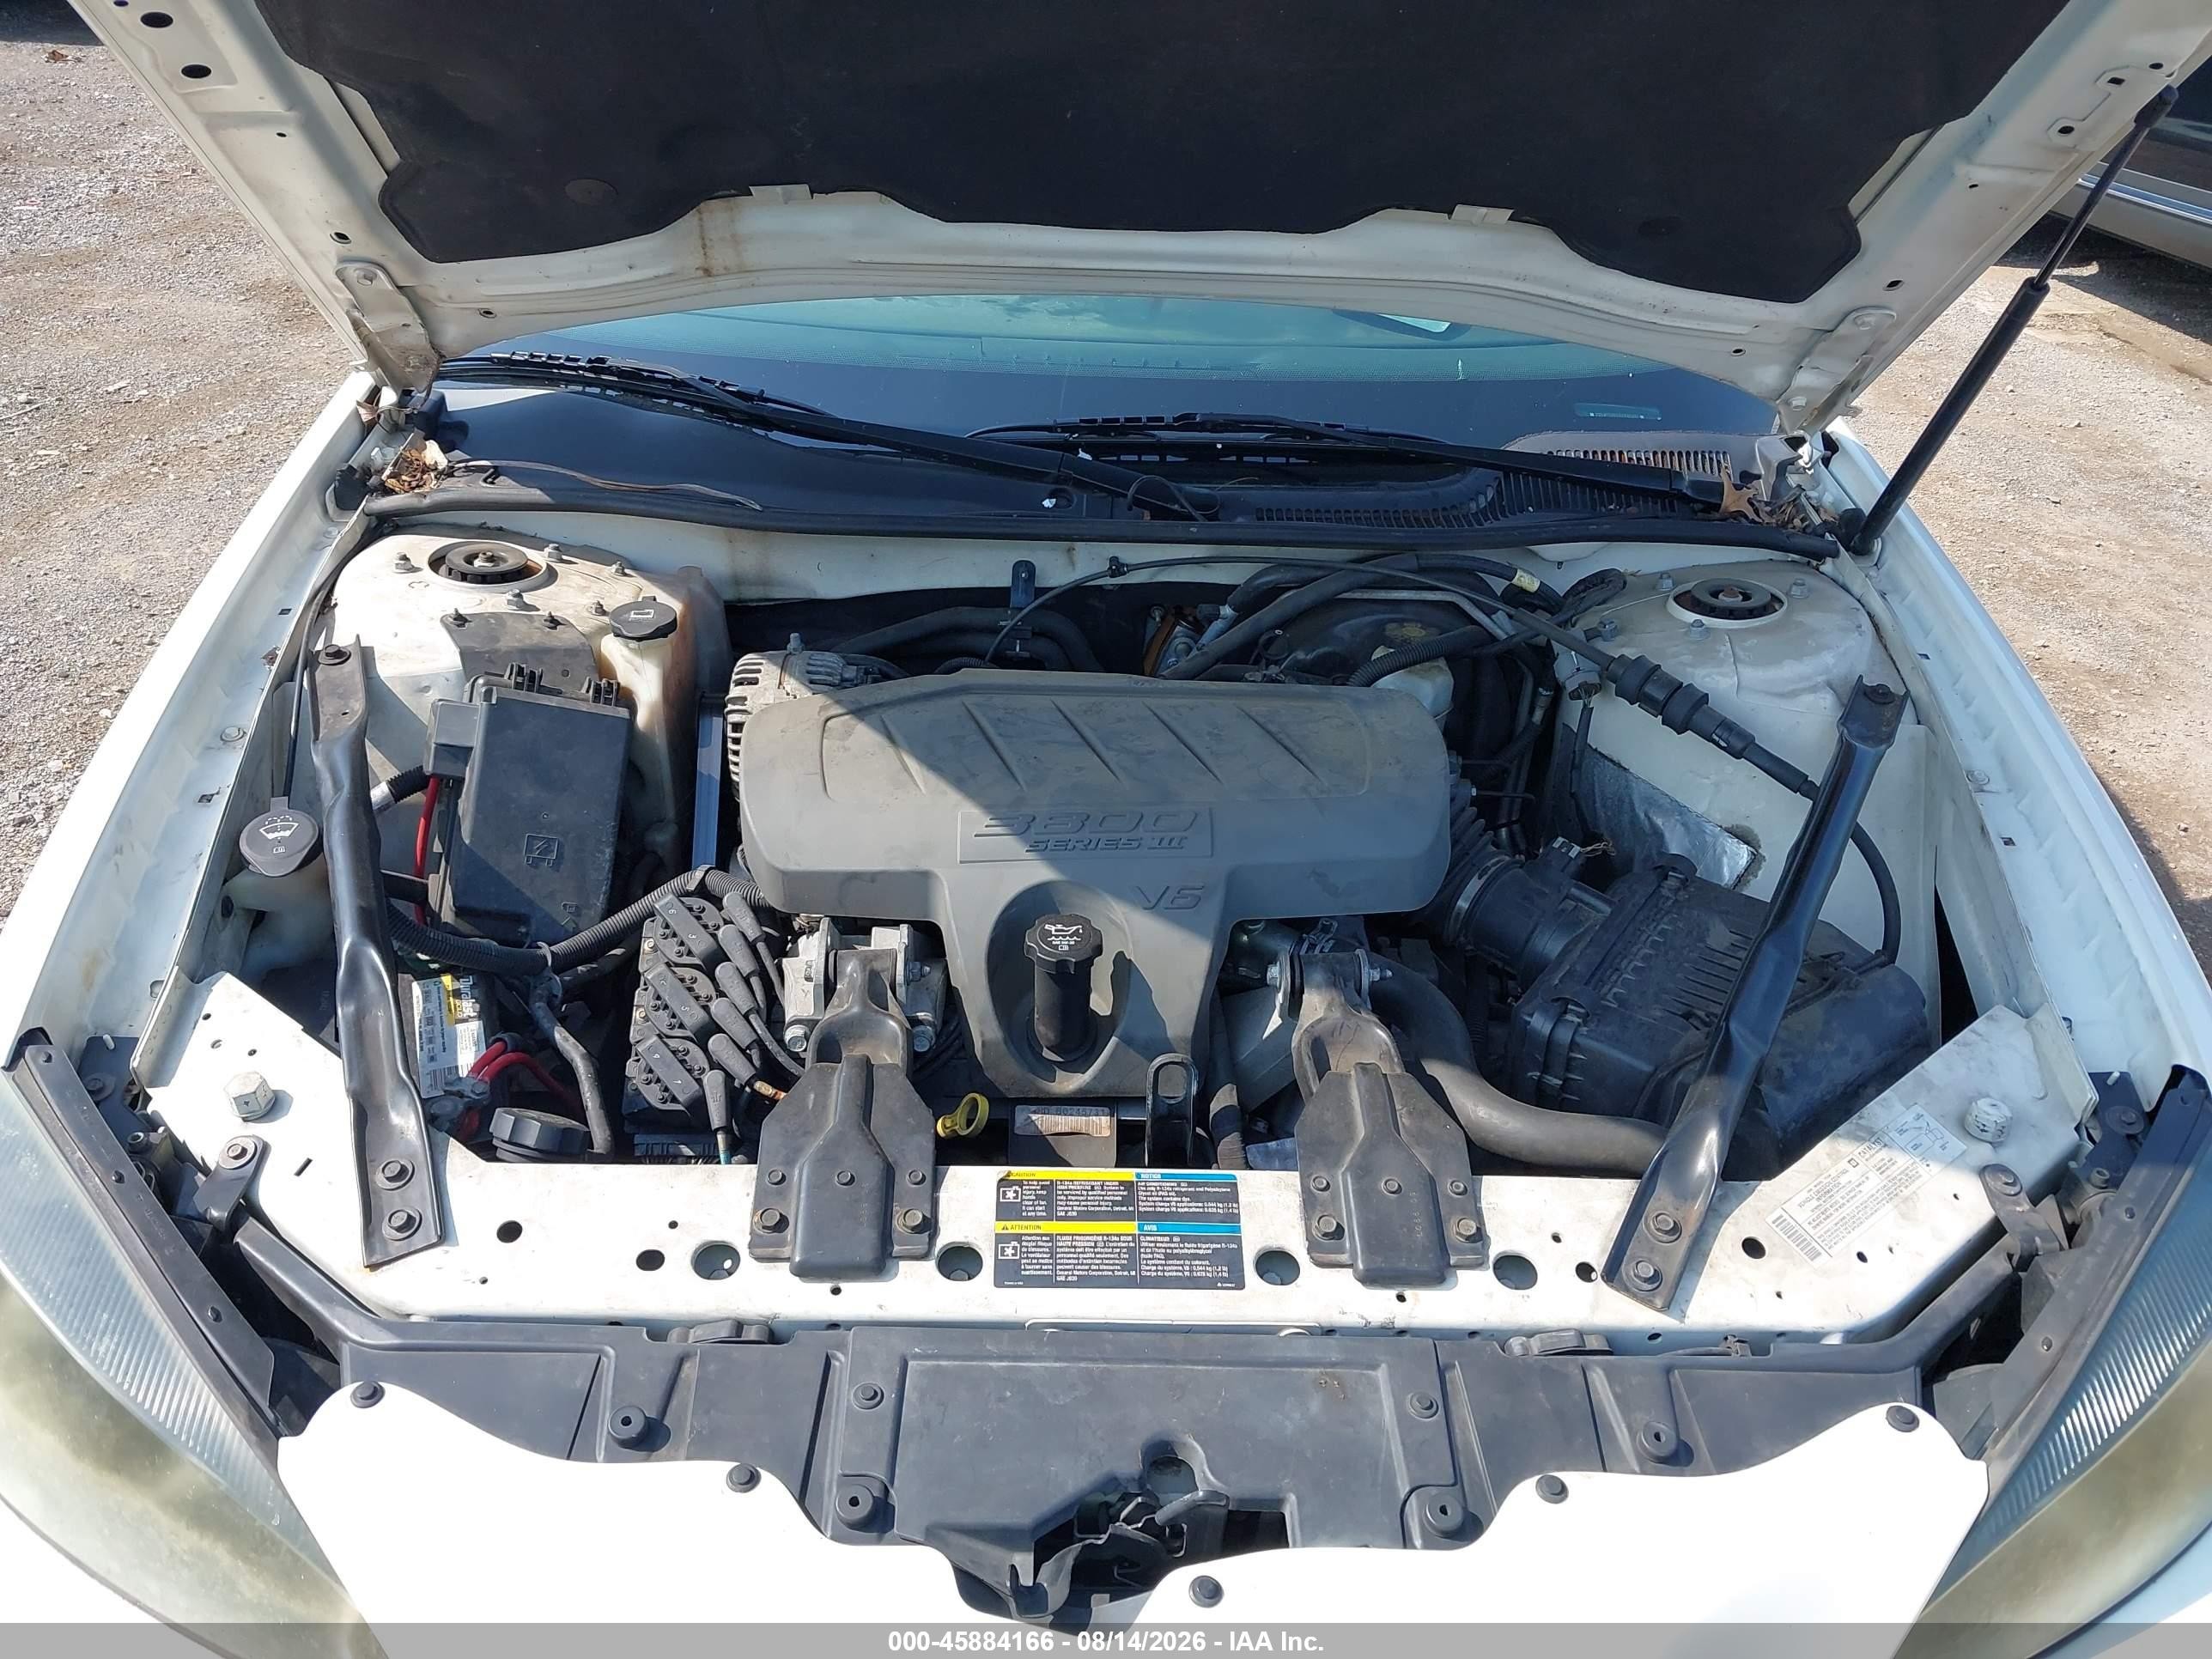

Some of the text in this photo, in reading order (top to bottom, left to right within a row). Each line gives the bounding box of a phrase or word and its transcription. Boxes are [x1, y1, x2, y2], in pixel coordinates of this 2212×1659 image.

[974, 811, 1199, 837] 3800
[1025, 836, 1188, 853] SERIES III
[1135, 885, 1205, 910] V6
[459, 975, 477, 1018] Duralast
[1858, 1137, 1884, 1158] CATALYST
